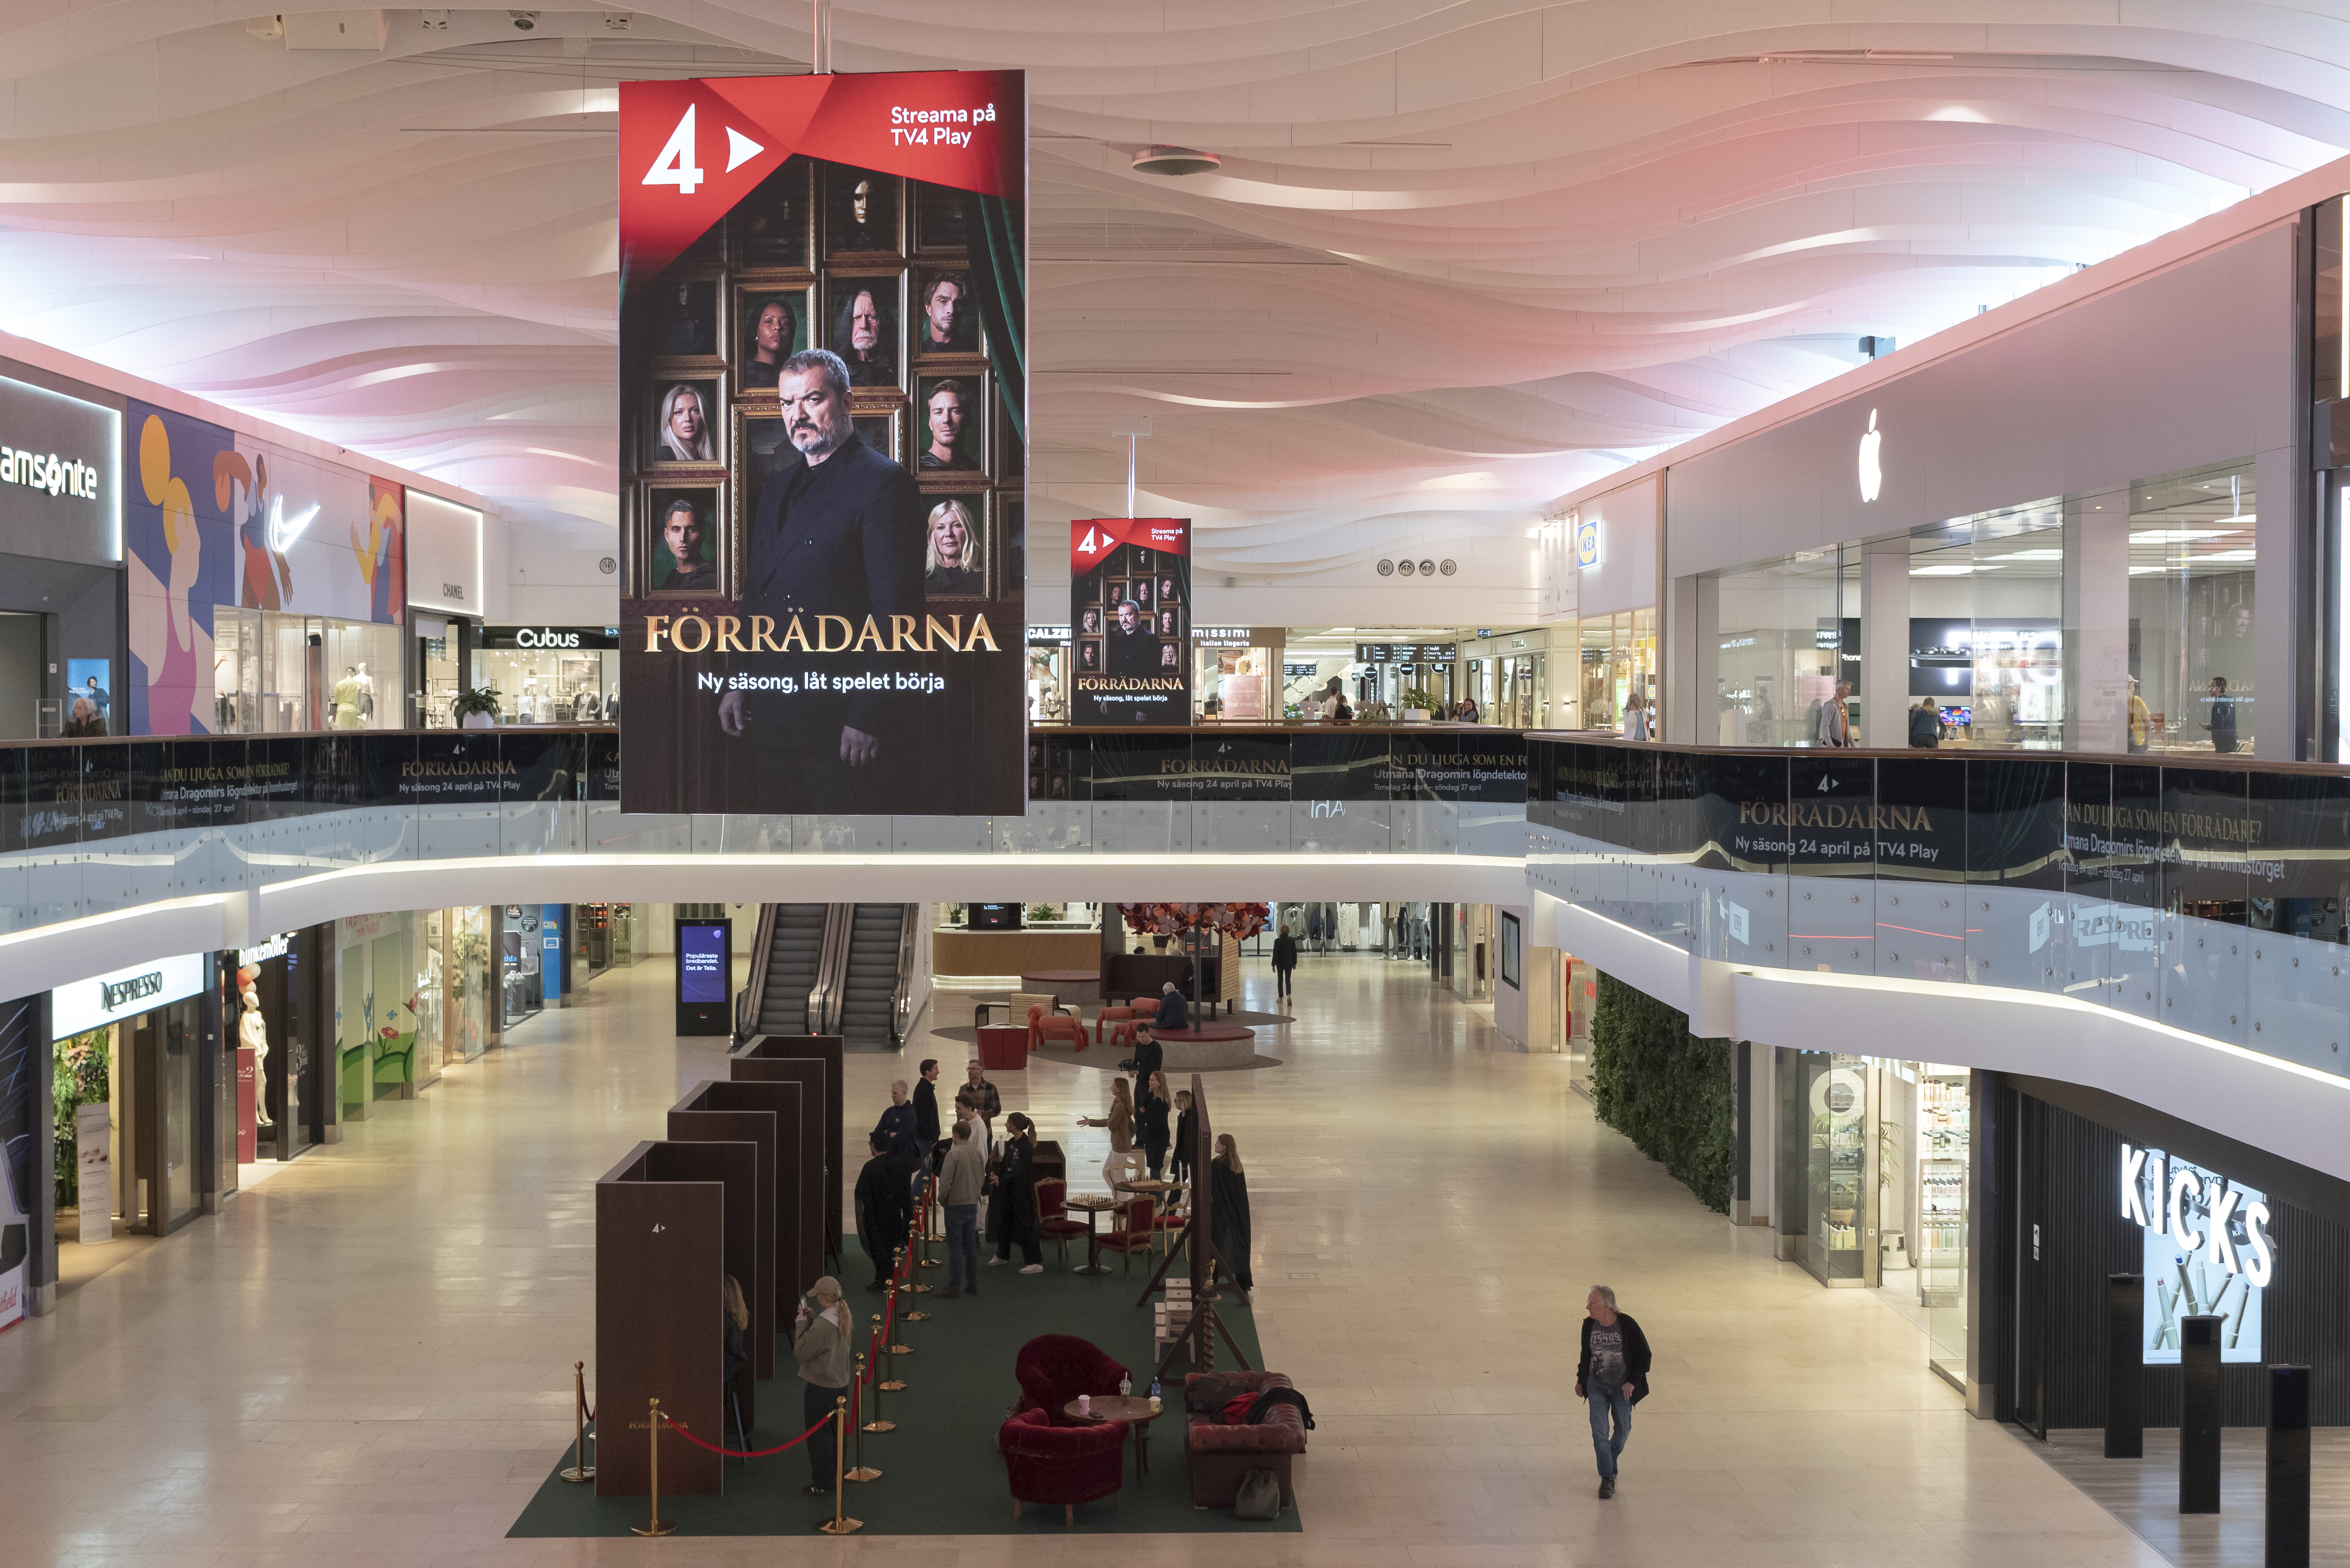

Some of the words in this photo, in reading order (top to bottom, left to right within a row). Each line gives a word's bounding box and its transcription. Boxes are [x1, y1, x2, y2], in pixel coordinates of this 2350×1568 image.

[891, 106, 967, 125] Streama
[972, 103, 995, 126] på
[891, 128, 929, 146] TV4
[933, 127, 972, 148] Play
[642, 103, 703, 194] 4
[0, 446, 97, 500] amsonite
[1077, 526, 1097, 554] 4
[1581, 535, 1595, 553] IKEA
[443, 583, 463, 600] CHANEL
[517, 628, 579, 647] Cubus
[644, 607, 1002, 653] FÖRRÄDARNA
[1028, 628, 1071, 639] CALZE
[698, 673, 724, 693] Ny
[728, 673, 798, 693] säsong,
[804, 672, 827, 690] låt
[832, 673, 890, 693] spelet
[896, 673, 944, 693] börja
[1078, 676, 1184, 690] FÖRRÄDARNA
[453, 744, 460, 754] 4
[1218, 743, 1225, 753] 4
[1408, 754, 1427, 765] DU
[1432, 754, 1470, 767] LJUGA
[1472, 755, 1496, 765] SOM
[1500, 755, 1514, 765] EN
[174, 768, 187, 782] DU
[191, 768, 224, 784] LJUGA
[226, 766, 246, 779] SOM
[1157, 780, 1169, 789] Ny
[1172, 779, 1204, 789] säsong
[1220, 779, 1239, 789] april
[1242, 779, 1252, 789] på
[1275, 779, 1293, 789] Play
[1374, 769, 1414, 779] Utmana
[1417, 769, 1470, 781] Dragomirs
[1818, 774, 1828, 792] 4
[180, 786, 225, 802] Dragomirs
[399, 784, 409, 794] Ny
[411, 783, 440, 793] säsong
[442, 782, 452, 791] 24
[455, 782, 472, 792] april
[474, 781, 484, 791] på
[486, 781, 502, 789] TV4
[503, 781, 521, 791] Play
[1374, 784, 1401, 792] Torsdag
[215, 804, 221, 813] 27
[223, 804, 235, 814] april
[1739, 797, 1934, 831] FÖRRÄDARNA
[2084, 804, 2099, 825] DU
[2102, 806, 2133, 832] LJUGA
[2137, 809, 2159, 832] SOM
[2163, 812, 2178, 833] EN
[1736, 836, 1750, 850] Ny
[1753, 837, 1795, 855] säsong
[1800, 839, 1817, 853] 24
[1821, 841, 1849, 857] april
[1854, 842, 1870, 858] på
[1878, 842, 1906, 857] TV4
[1910, 844, 1938, 862] Play
[2091, 833, 2134, 859] Dragomirs
[2196, 848, 2208, 872] på
[2210, 849, 2285, 883] Inomhustorget
[2124, 869, 2131, 881] 27
[2132, 870, 2144, 884] april
[239, 934, 289, 967] hunkemöller
[99, 971, 162, 1012] NESPRESSO
[2122, 1143, 2274, 1287] KICKS
[652, 1223, 660, 1234] 4
